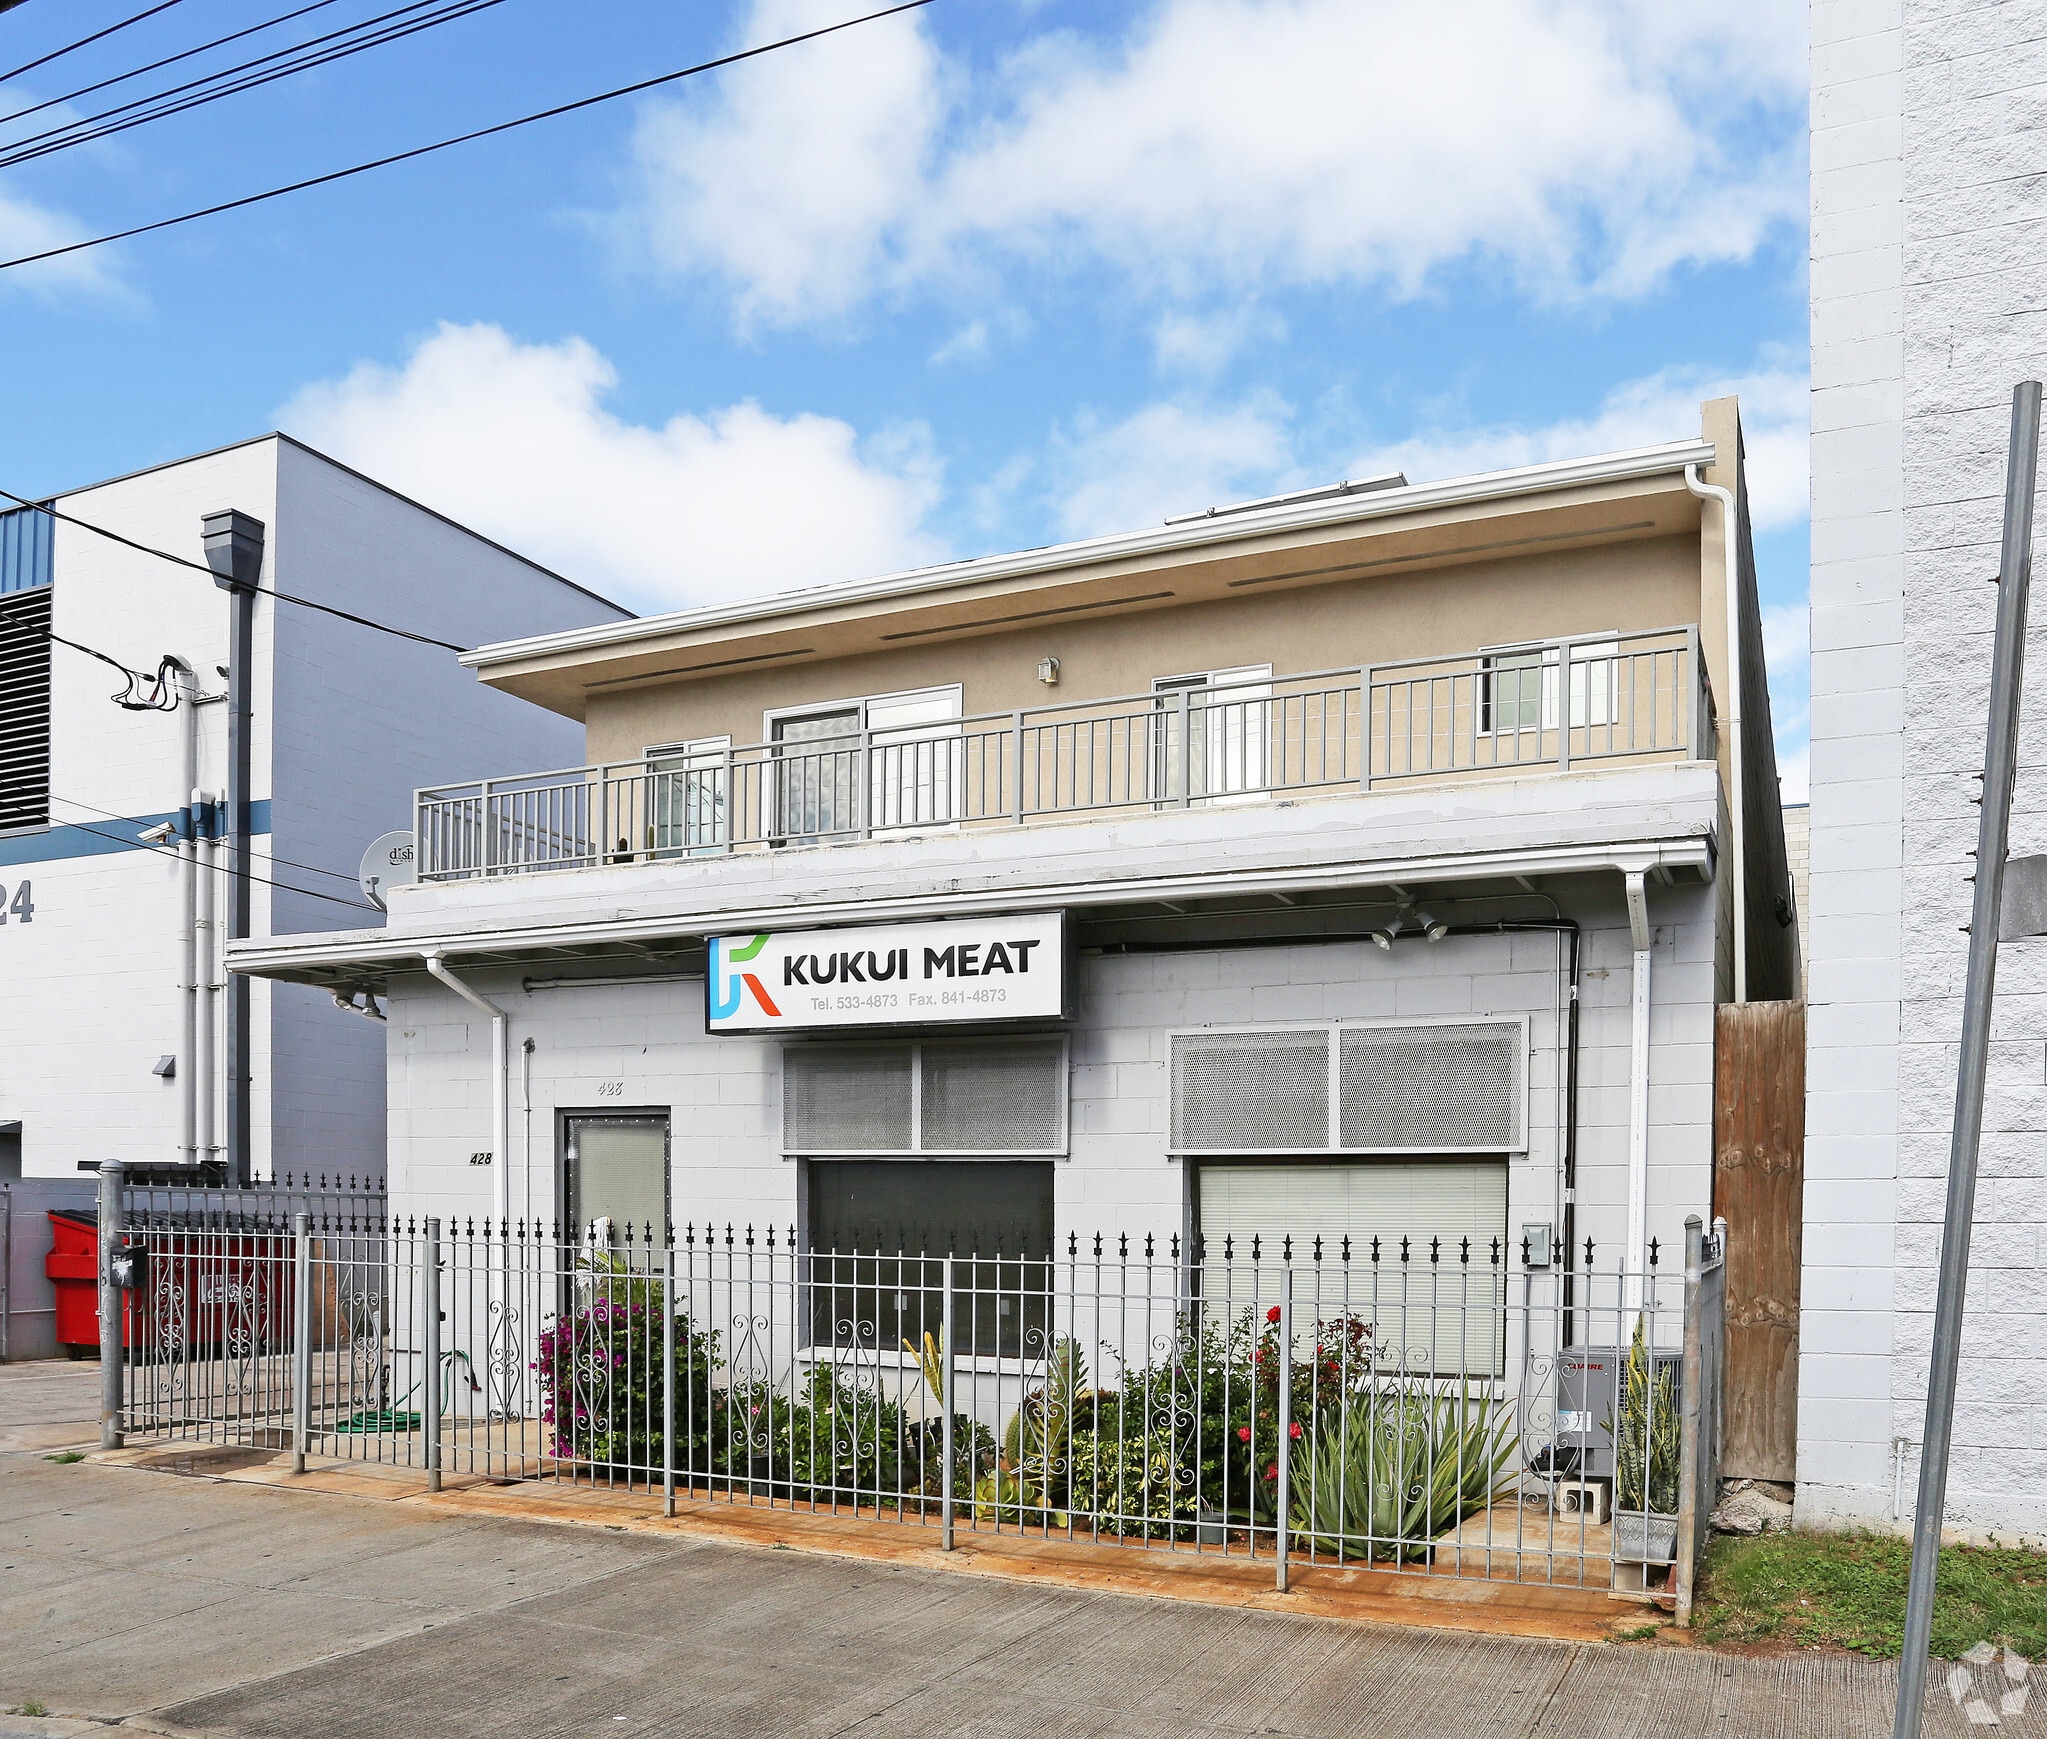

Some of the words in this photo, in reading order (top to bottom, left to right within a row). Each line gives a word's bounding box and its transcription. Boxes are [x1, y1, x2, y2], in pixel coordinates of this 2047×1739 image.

[390, 847, 413, 860] dish
[784, 948, 908, 986] KUKUI
[923, 939, 1041, 979] MEAT
[810, 997, 833, 1011] Tel.
[836, 994, 898, 1010] 533-4873
[908, 992, 937, 1007] Fax.
[941, 988, 1007, 1005] 841-4873
[469, 1152, 492, 1165] 428
